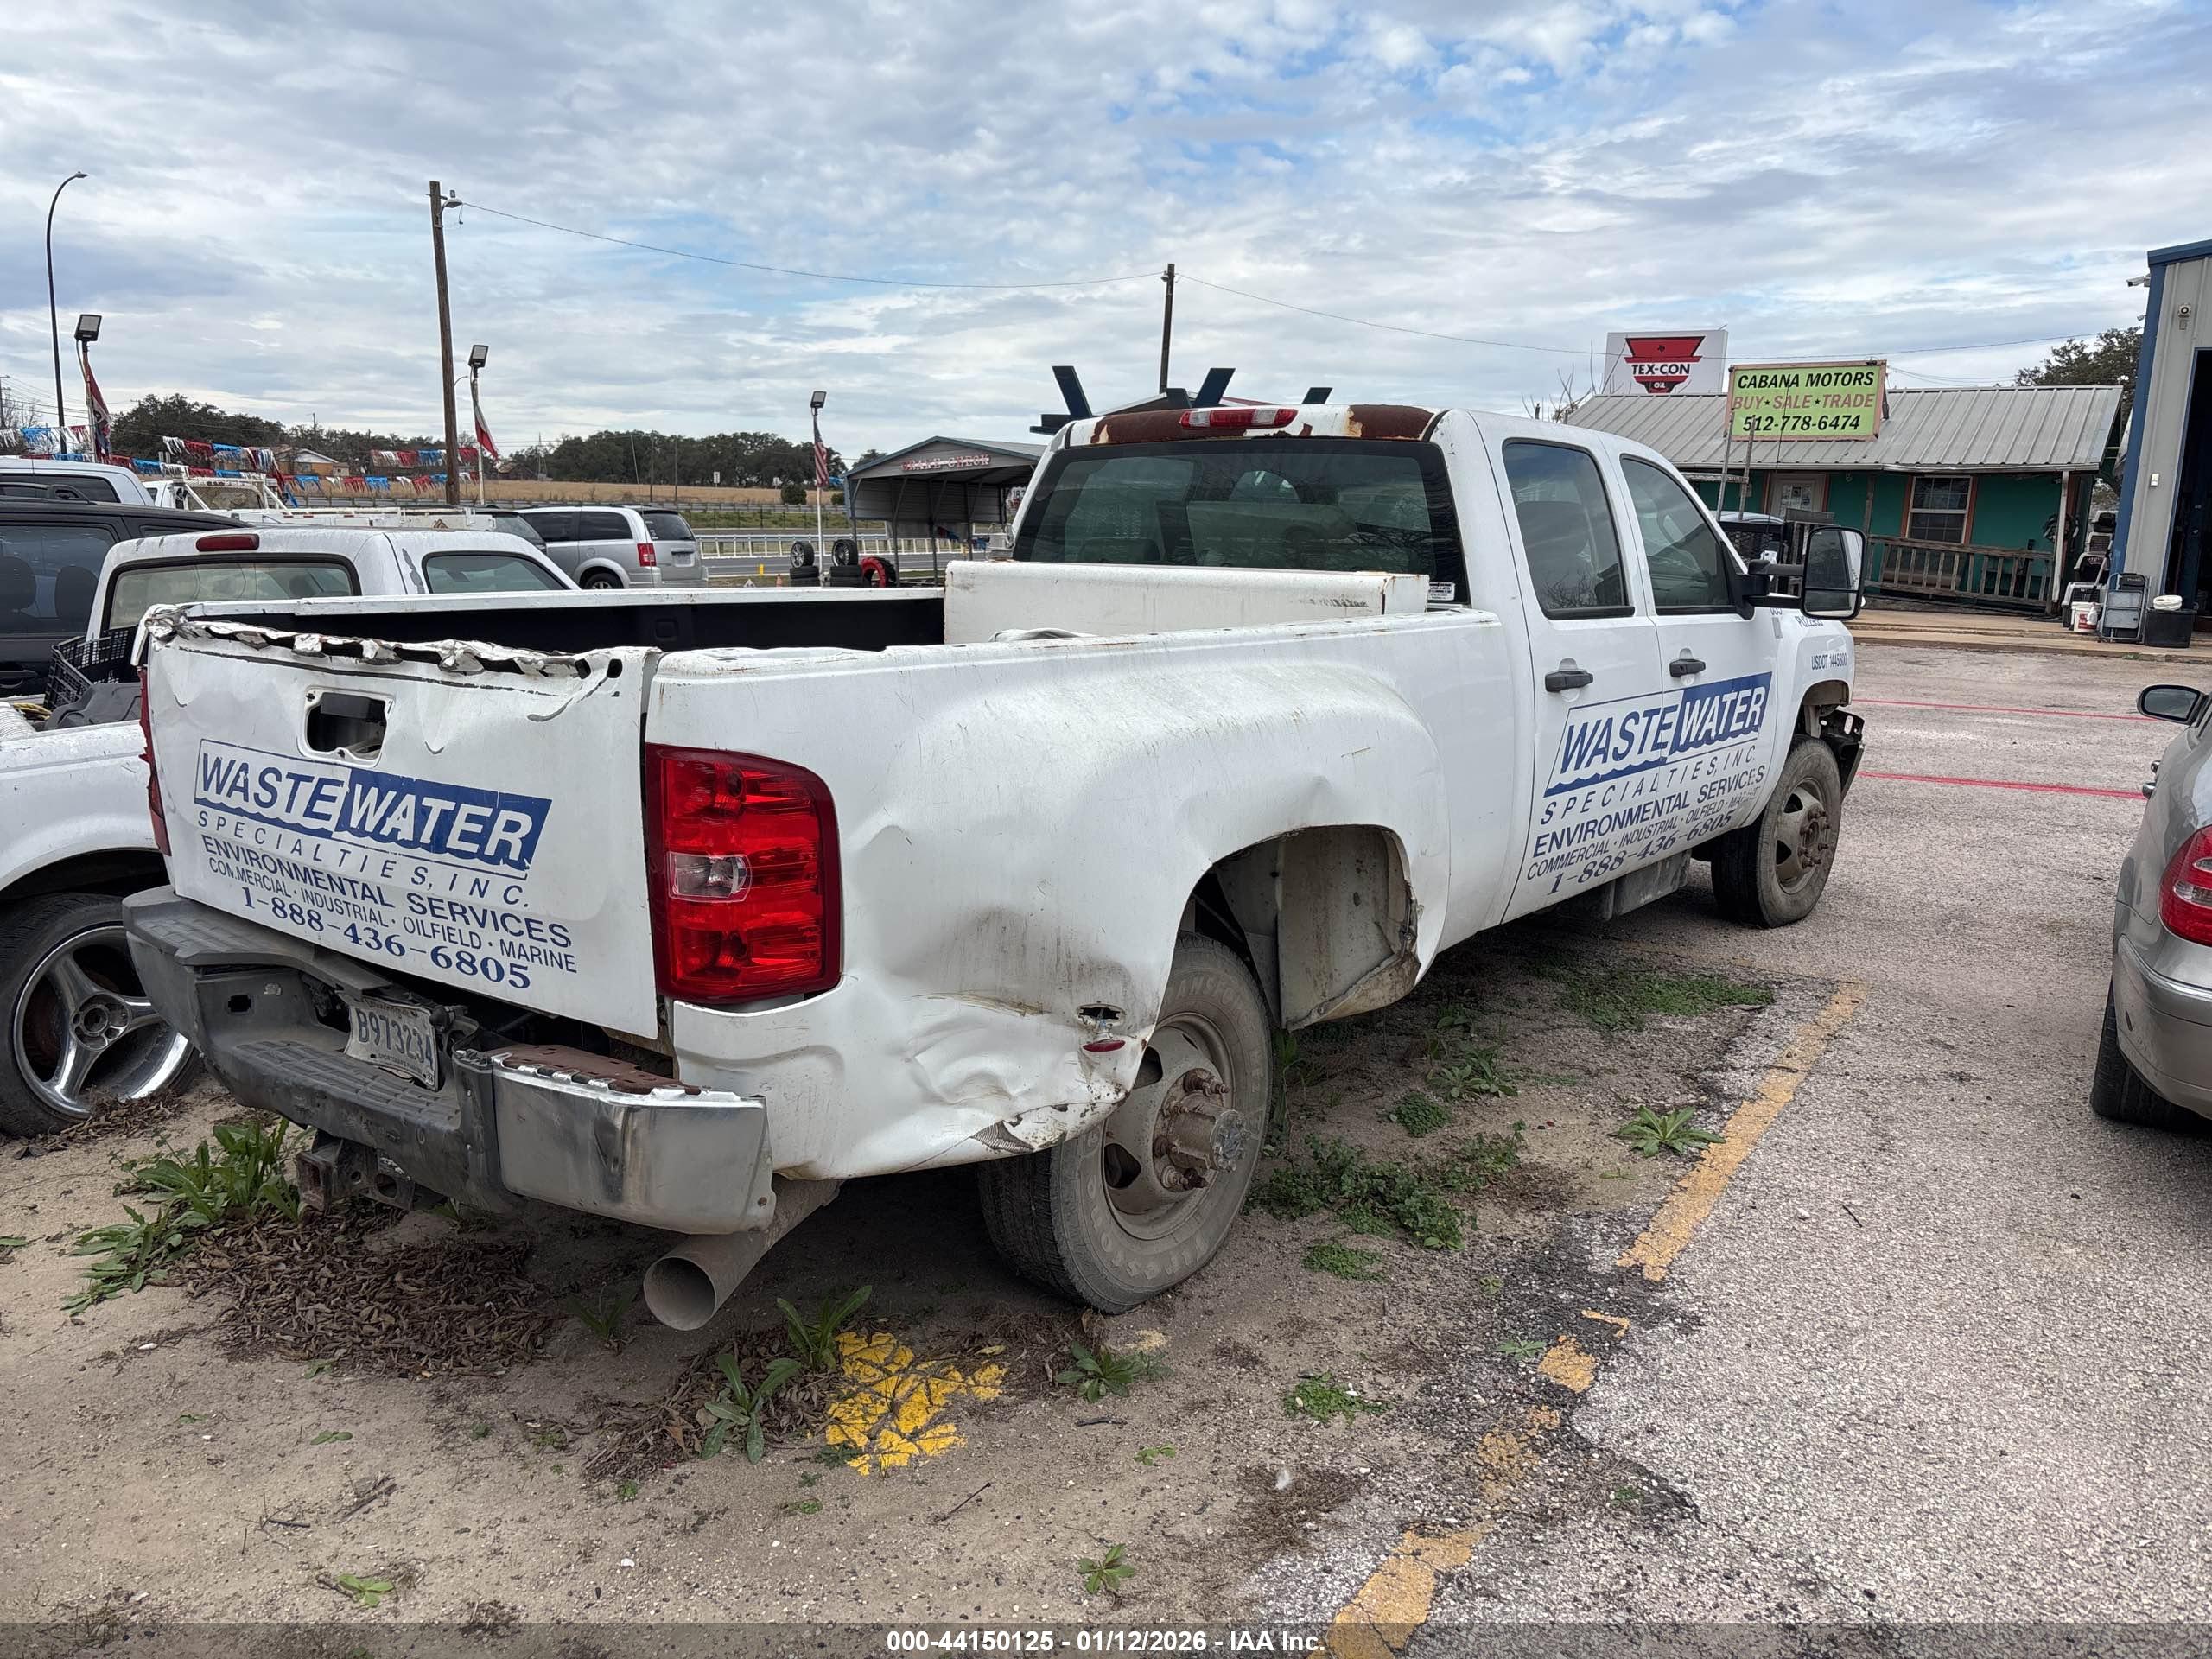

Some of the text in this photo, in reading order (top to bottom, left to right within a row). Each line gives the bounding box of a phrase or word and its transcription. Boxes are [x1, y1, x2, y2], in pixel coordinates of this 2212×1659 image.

[1630, 363, 1691, 375] TEX-CON
[1737, 371, 1875, 390] CABANA MOTORS
[1732, 392, 1876, 410] BUY SALE TRADE
[1742, 414, 1861, 431] 512-778-6474
[948, 454, 990, 470] CHECK
[1811, 653, 1828, 670] USDOT
[1532, 765, 1765, 858] ENVIRONMENTAL SERVICES
[1527, 841, 1609, 880] COMMERCIAL
[1618, 815, 1678, 848] INDUSTRIAL
[1686, 799, 1725, 824] OILFIELD
[1547, 810, 1736, 896] 1-888-436-6805
[200, 834, 572, 949] ENVIRONMENTAL SERVICES
[448, 873, 529, 908] INC.
[209, 857, 578, 975] COMMERCIAL INDUSTRIAL OILFIELD MARINE
[242, 887, 531, 989] 1-888-436-6805
[354, 1007, 434, 1072] B973234
